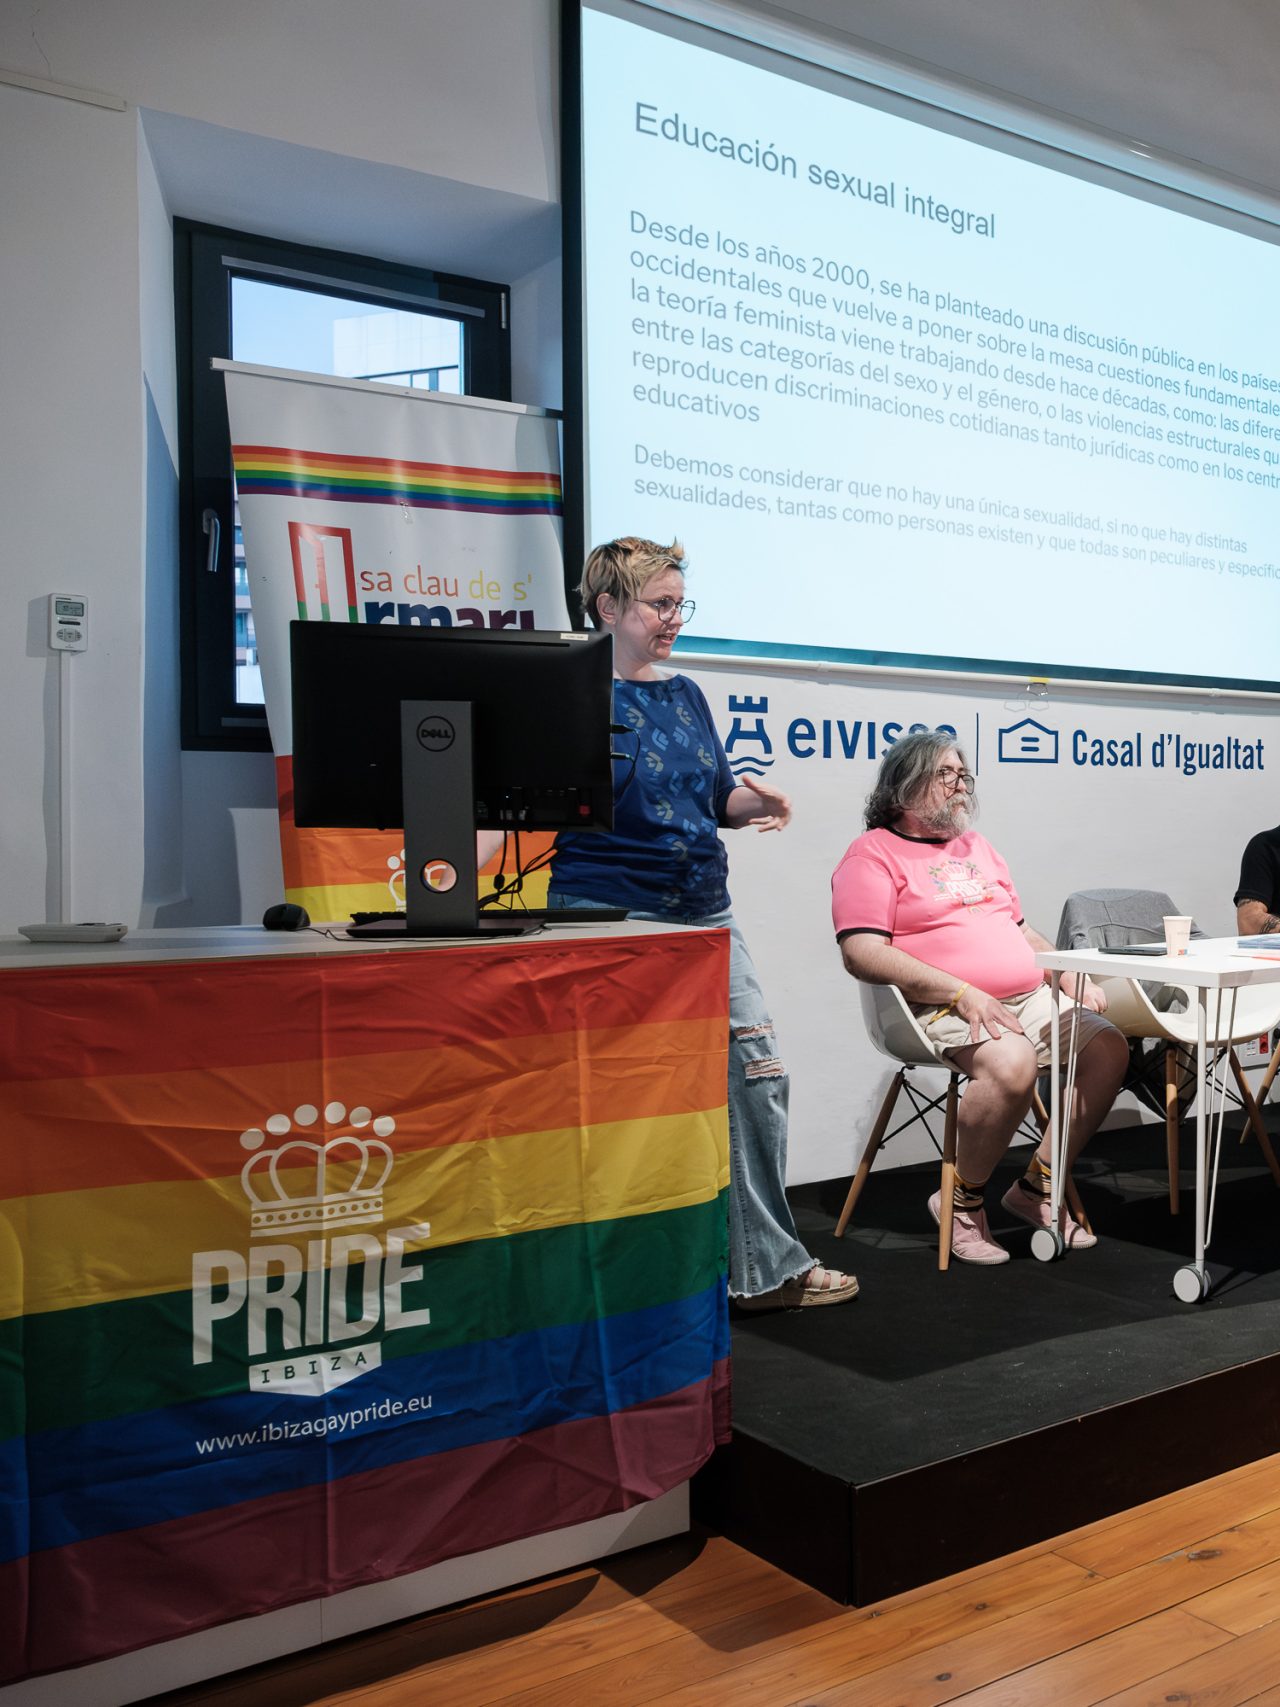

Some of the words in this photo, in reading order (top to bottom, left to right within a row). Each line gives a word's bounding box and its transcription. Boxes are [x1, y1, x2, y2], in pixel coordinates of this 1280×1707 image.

[635, 101, 797, 179] Educación
[808, 164, 895, 208] sexual
[905, 186, 995, 239] integral
[630, 209, 710, 249] Desde
[717, 230, 749, 259] los
[755, 244, 807, 274] años
[812, 256, 874, 295] 2000,
[880, 280, 902, 298] se
[908, 281, 930, 306] ha
[935, 292, 1024, 330] planteado
[1028, 318, 1059, 338] una
[1063, 324, 1138, 358] discusión
[1142, 346, 1194, 372] pública
[1198, 362, 1216, 377] en
[1218, 362, 1238, 384] los
[630, 250, 782, 298] occidentales
[788, 286, 827, 310] que
[832, 297, 897, 327] vuelve
[902, 315, 913, 330] a
[918, 319, 973, 344] poner
[976, 333, 1027, 358] sobre
[1031, 342, 1045, 362] la
[1049, 351, 1094, 374] mesa
[1097, 362, 1181, 394] cuestiones
[631, 277, 650, 304] la
[656, 285, 727, 320] teoría
[734, 300, 836, 342] feminista
[841, 328, 895, 356] viene
[899, 339, 999, 379] trabajando
[1003, 364, 1056, 392] desde
[1060, 376, 1099, 402] hace
[1102, 387, 1170, 419] décadas,
[1173, 406, 1217, 428] como:
[1220, 412, 1240, 433] las
[631, 317, 694, 346] entre
[702, 327, 734, 354] las
[740, 340, 855, 376] categorías
[860, 360, 889, 384] del
[894, 372, 938, 394] sexo
[942, 382, 953, 401] y
[957, 383, 973, 402] el
[977, 388, 1042, 418] género,
[1046, 404, 1057, 419] o
[1061, 403, 1083, 425] las
[1087, 410, 1164, 441] violencias
[1166, 430, 1260, 461] estructurales
[632, 383, 760, 422] educativos
[632, 350, 768, 392] reproducen
[774, 373, 945, 425] discriminaciones
[949, 412, 1040, 443] cotidianas
[1043, 428, 1087, 452] tanto
[1089, 436, 1155, 465] jurídicas
[1158, 454, 1199, 474] como
[1202, 462, 1220, 478] en
[1223, 462, 1244, 482] los
[634, 443, 734, 479] Debemos
[738, 466, 844, 493] considerar
[847, 480, 882, 499] que
[886, 486, 908, 502] no
[912, 485, 942, 510] hay
[945, 495, 975, 512] una
[978, 497, 1020, 519] única
[1023, 508, 1104, 534] sexualidad,
[1106, 518, 1118, 534] si
[1121, 523, 1139, 537] no
[1141, 526, 1167, 542] que
[1169, 527, 1193, 548] hay
[1195, 531, 1248, 554] distintas
[634, 478, 771, 515] sexualidades,
[776, 496, 837, 520] tantas
[842, 507, 894, 526] como
[898, 514, 974, 537] personas
[978, 524, 1034, 546] existen
[1036, 534, 1046, 550] y
[1048, 535, 1076, 552] que
[1080, 537, 1120, 558] todas
[1122, 546, 1147, 561] son
[1150, 550, 1216, 570] peculiares
[1218, 560, 1226, 575] y
[360, 570, 392, 592] sa
[404, 565, 459, 598] clau
[469, 570, 501, 600] de
[513, 574, 532, 600] s'
[421, 729, 451, 739] DELL
[787, 718, 958, 763] eivis
[1072, 729, 1142, 768] Casal
[192, 1222, 430, 1365] PRIDE
[261, 1351, 367, 1384] IBIZA
[196, 1395, 432, 1455] www.ibizagaypride.eu
